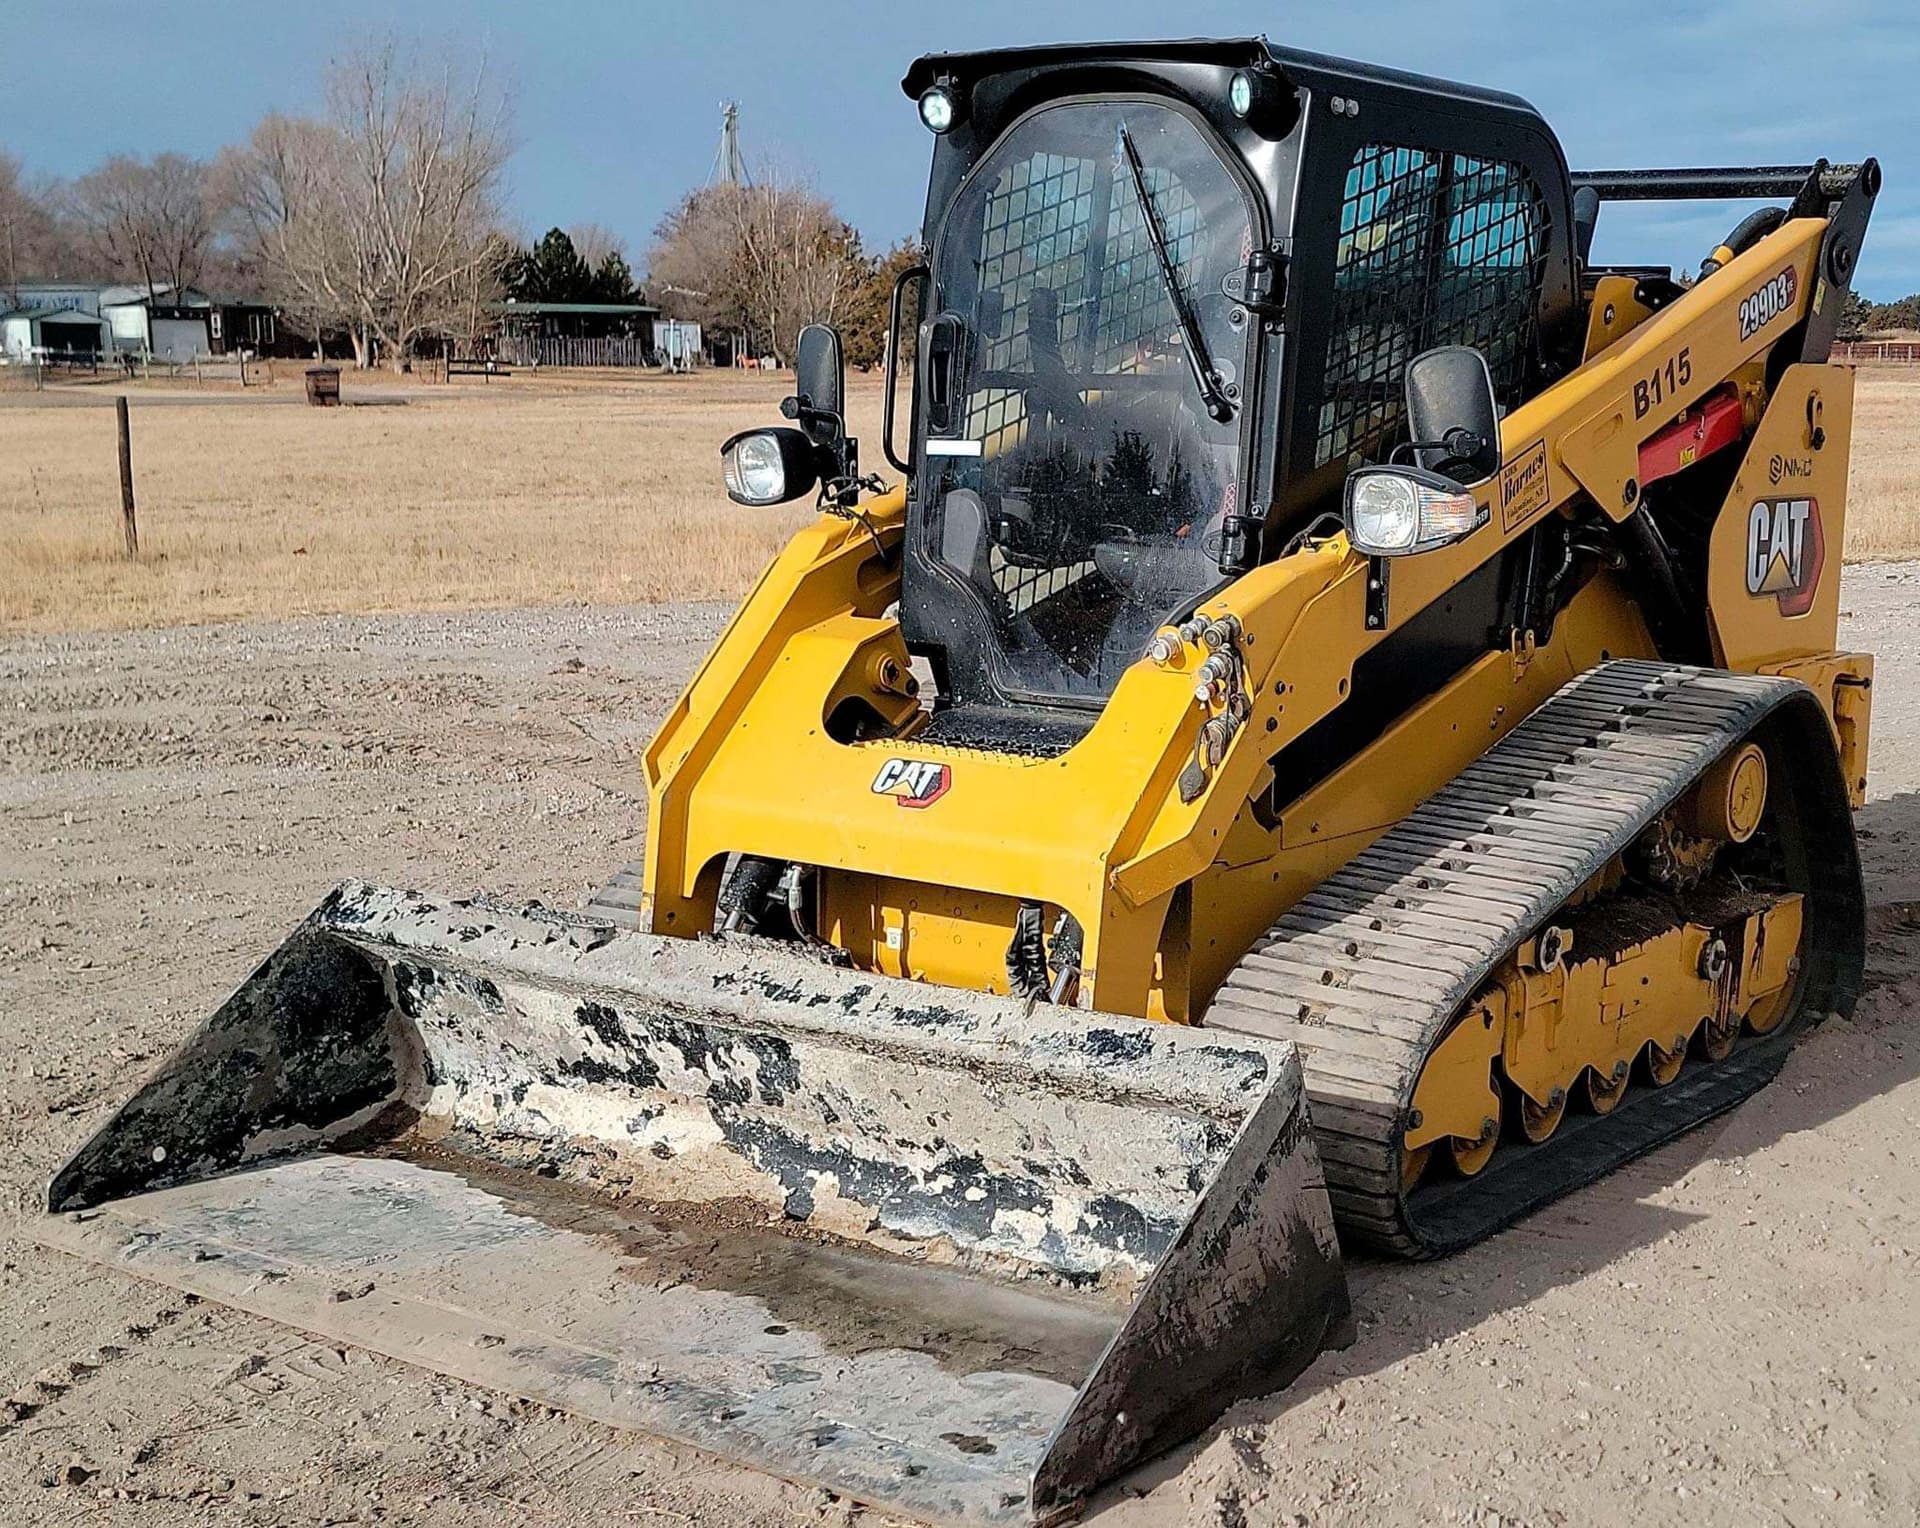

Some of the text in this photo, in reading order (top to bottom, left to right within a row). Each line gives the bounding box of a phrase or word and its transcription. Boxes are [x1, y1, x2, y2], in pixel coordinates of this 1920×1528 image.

[1739, 272, 1788, 341] 299D3
[1633, 346, 1691, 421] B115
[1504, 450, 1544, 507] Barnes
[1747, 500, 1810, 593] CAT
[872, 759, 943, 799] CAT
